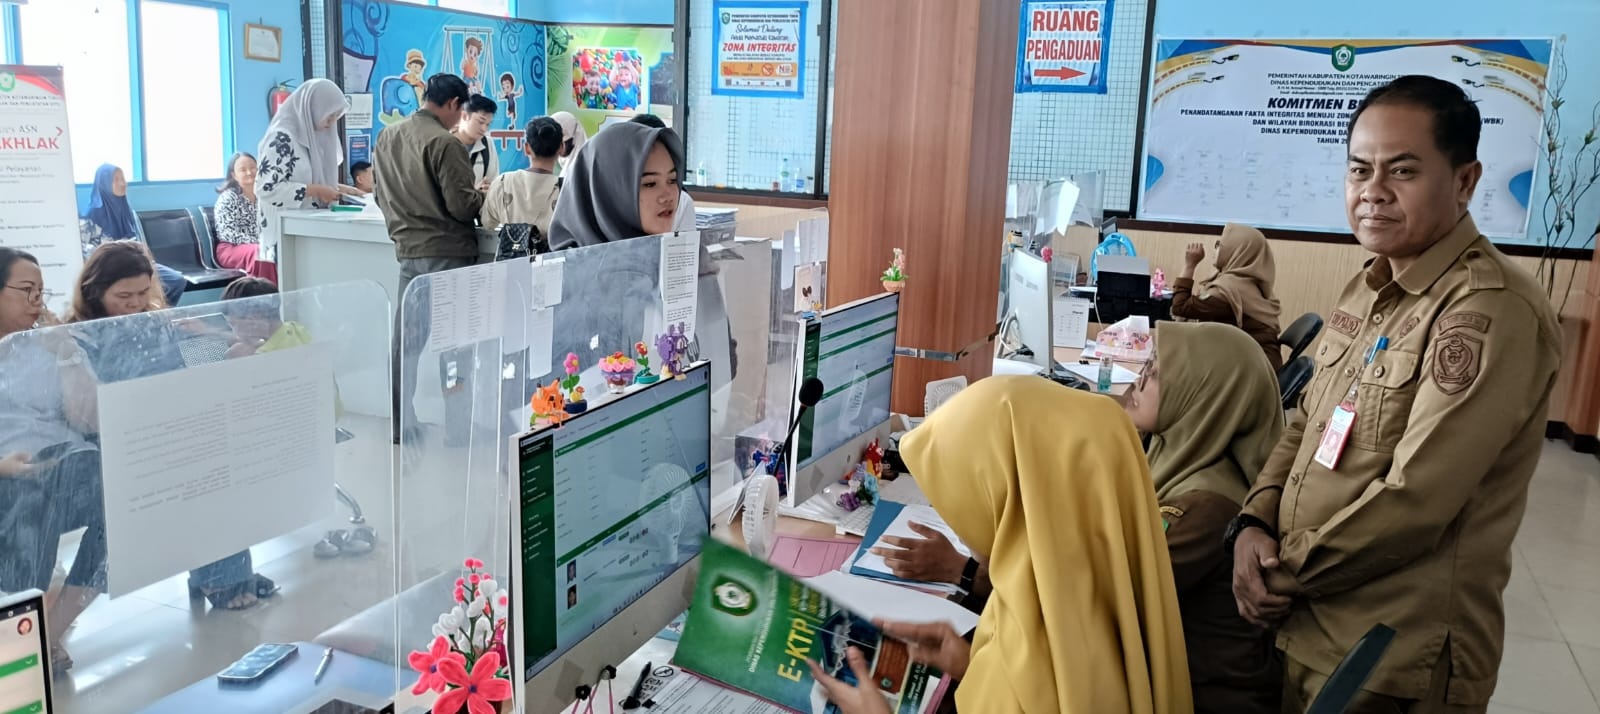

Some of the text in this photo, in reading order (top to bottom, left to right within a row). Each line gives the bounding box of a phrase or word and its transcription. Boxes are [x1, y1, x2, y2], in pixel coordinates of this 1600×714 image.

[1033, 10, 1099, 32] RUANG
[722, 43, 796, 53] ZONA INTEGRITAS
[1026, 39, 1100, 61] PENGADUAN
[1267, 97, 1344, 110] KOMITMEN
[20, 125, 38, 133] ASN
[0, 137, 60, 150] KHLAK
[777, 617, 815, 683] E-KTP
